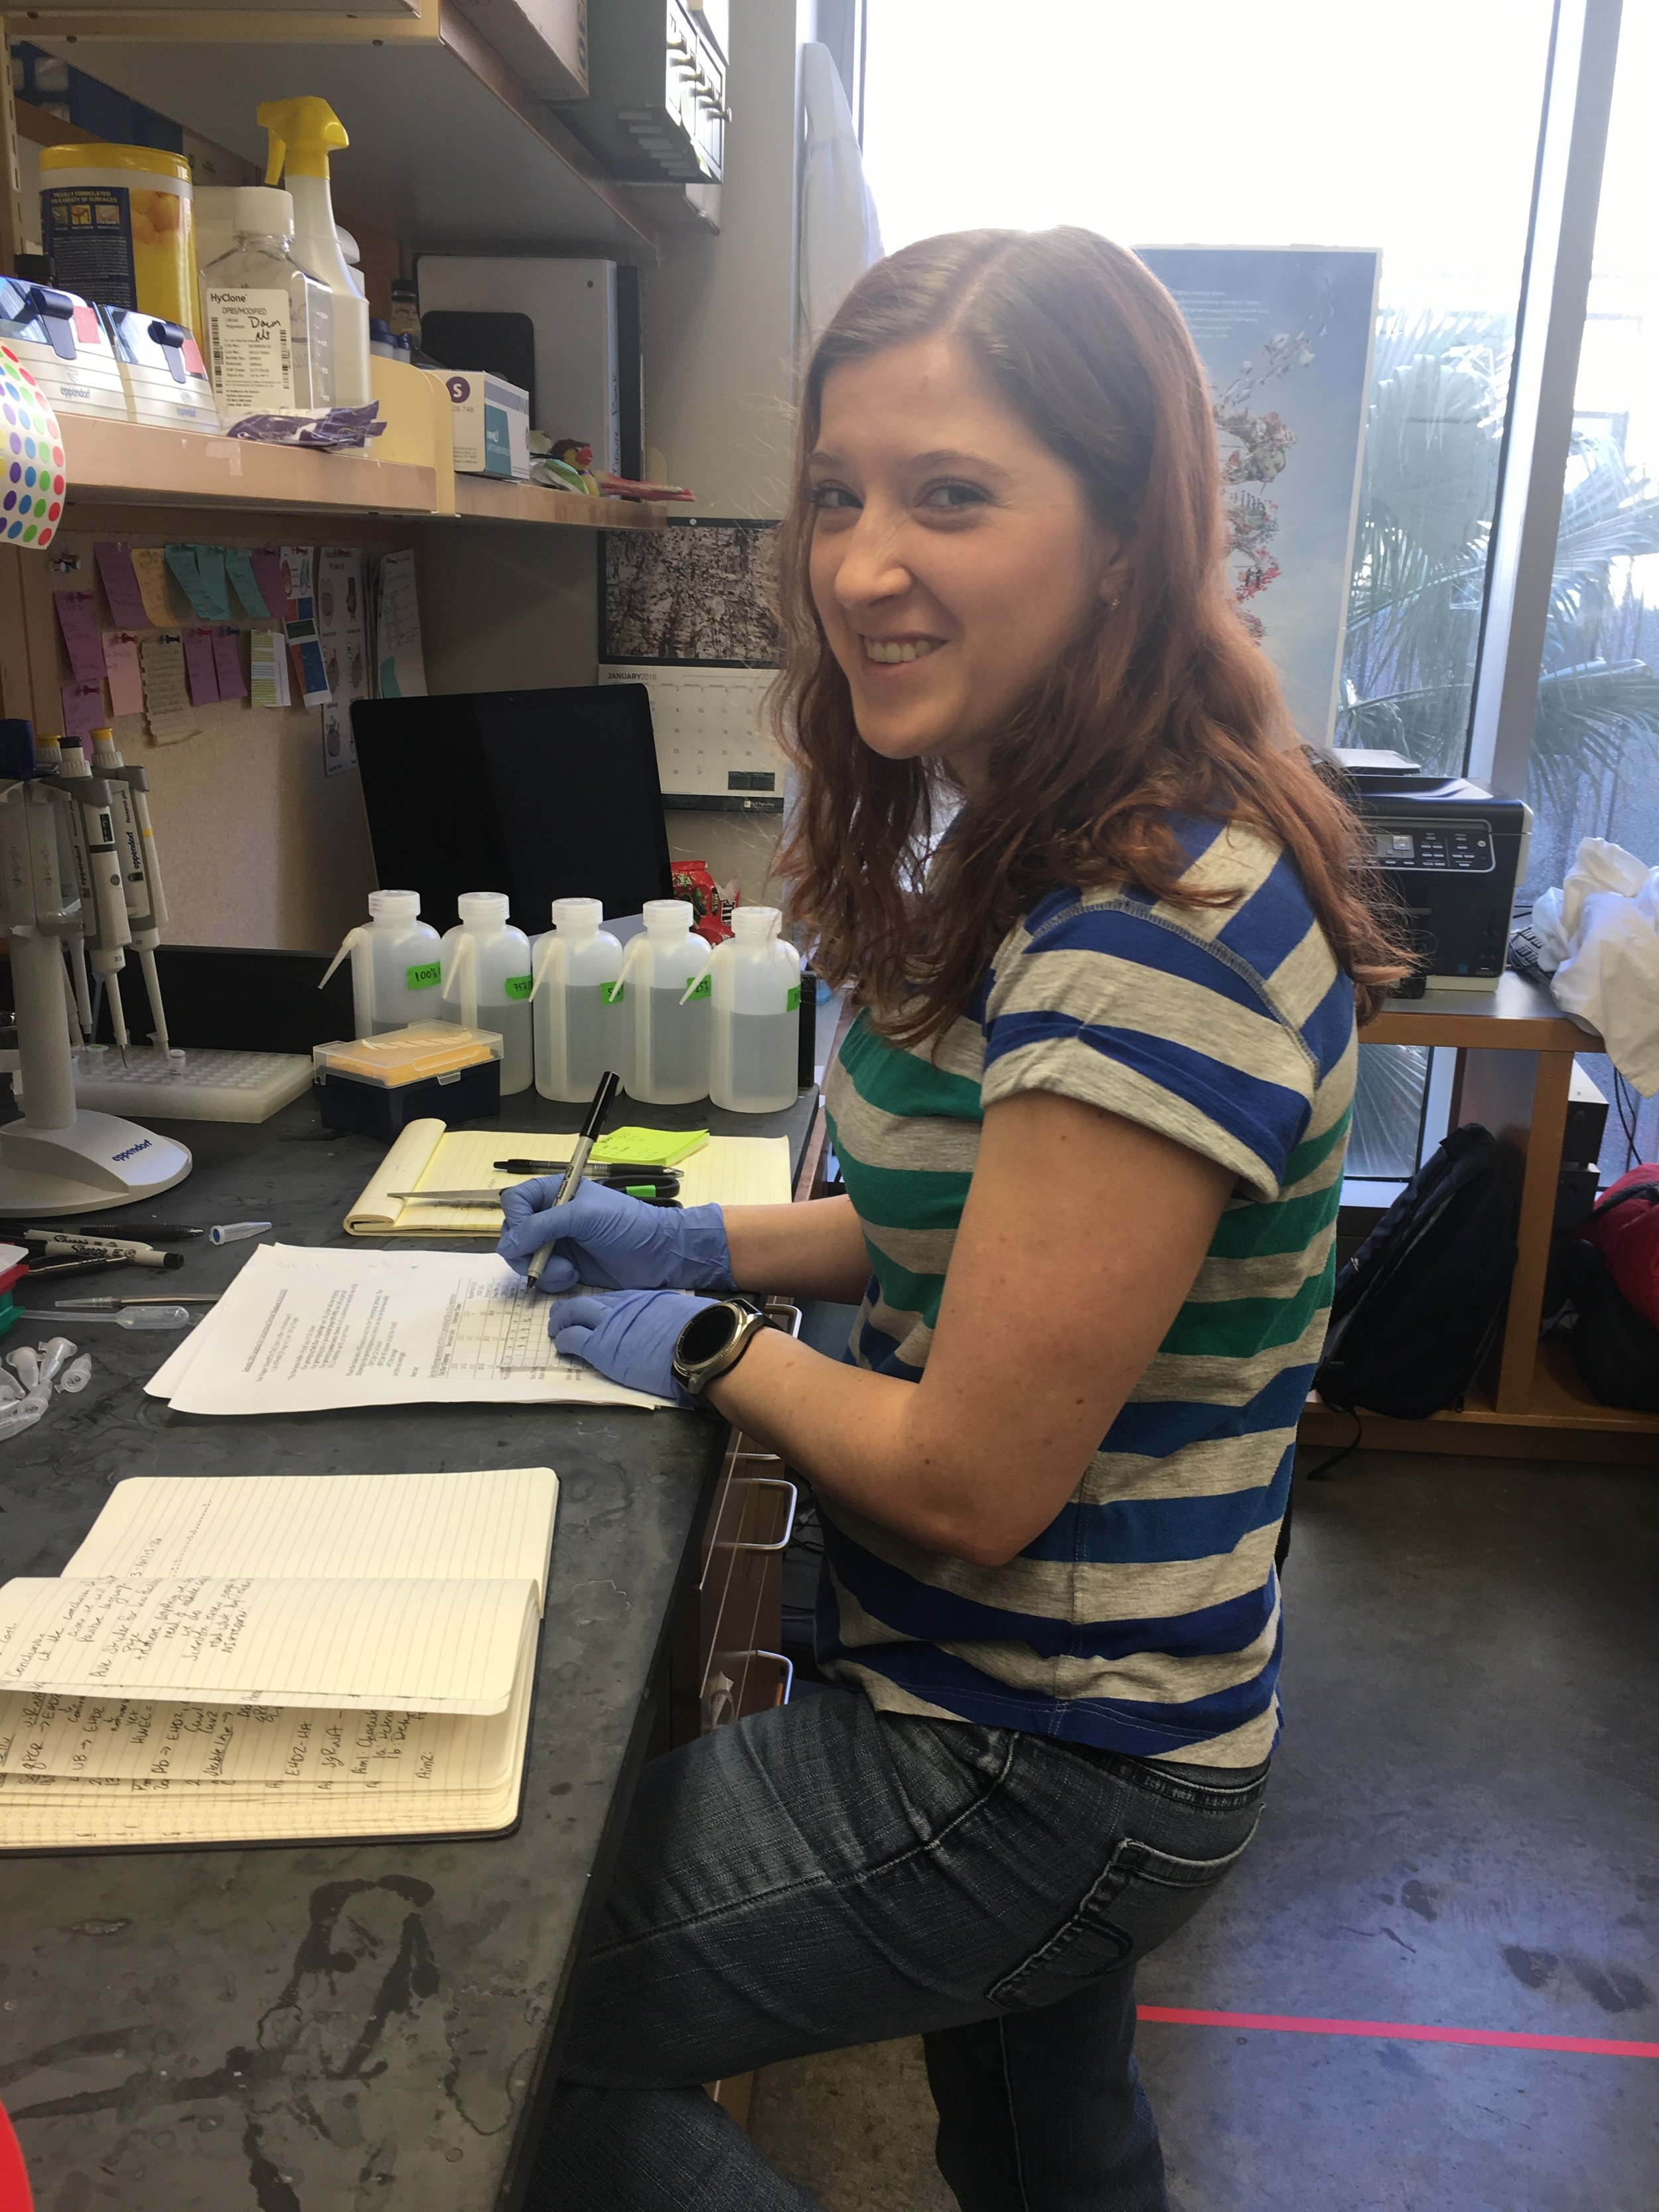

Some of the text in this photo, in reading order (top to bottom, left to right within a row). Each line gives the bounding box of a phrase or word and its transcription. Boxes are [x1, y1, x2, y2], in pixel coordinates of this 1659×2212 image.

[210, 293, 246, 303] HyClone
[60, 386, 91, 400] eppendorf
[453, 383, 463, 398] S
[125, 831, 141, 870] eppendorf
[74, 844, 87, 886] eppendorf
[111, 1139, 153, 1162] eppendorf
[82, 1706, 105, 1732] EHD2
[21, 1742, 47, 1771] qPCR
